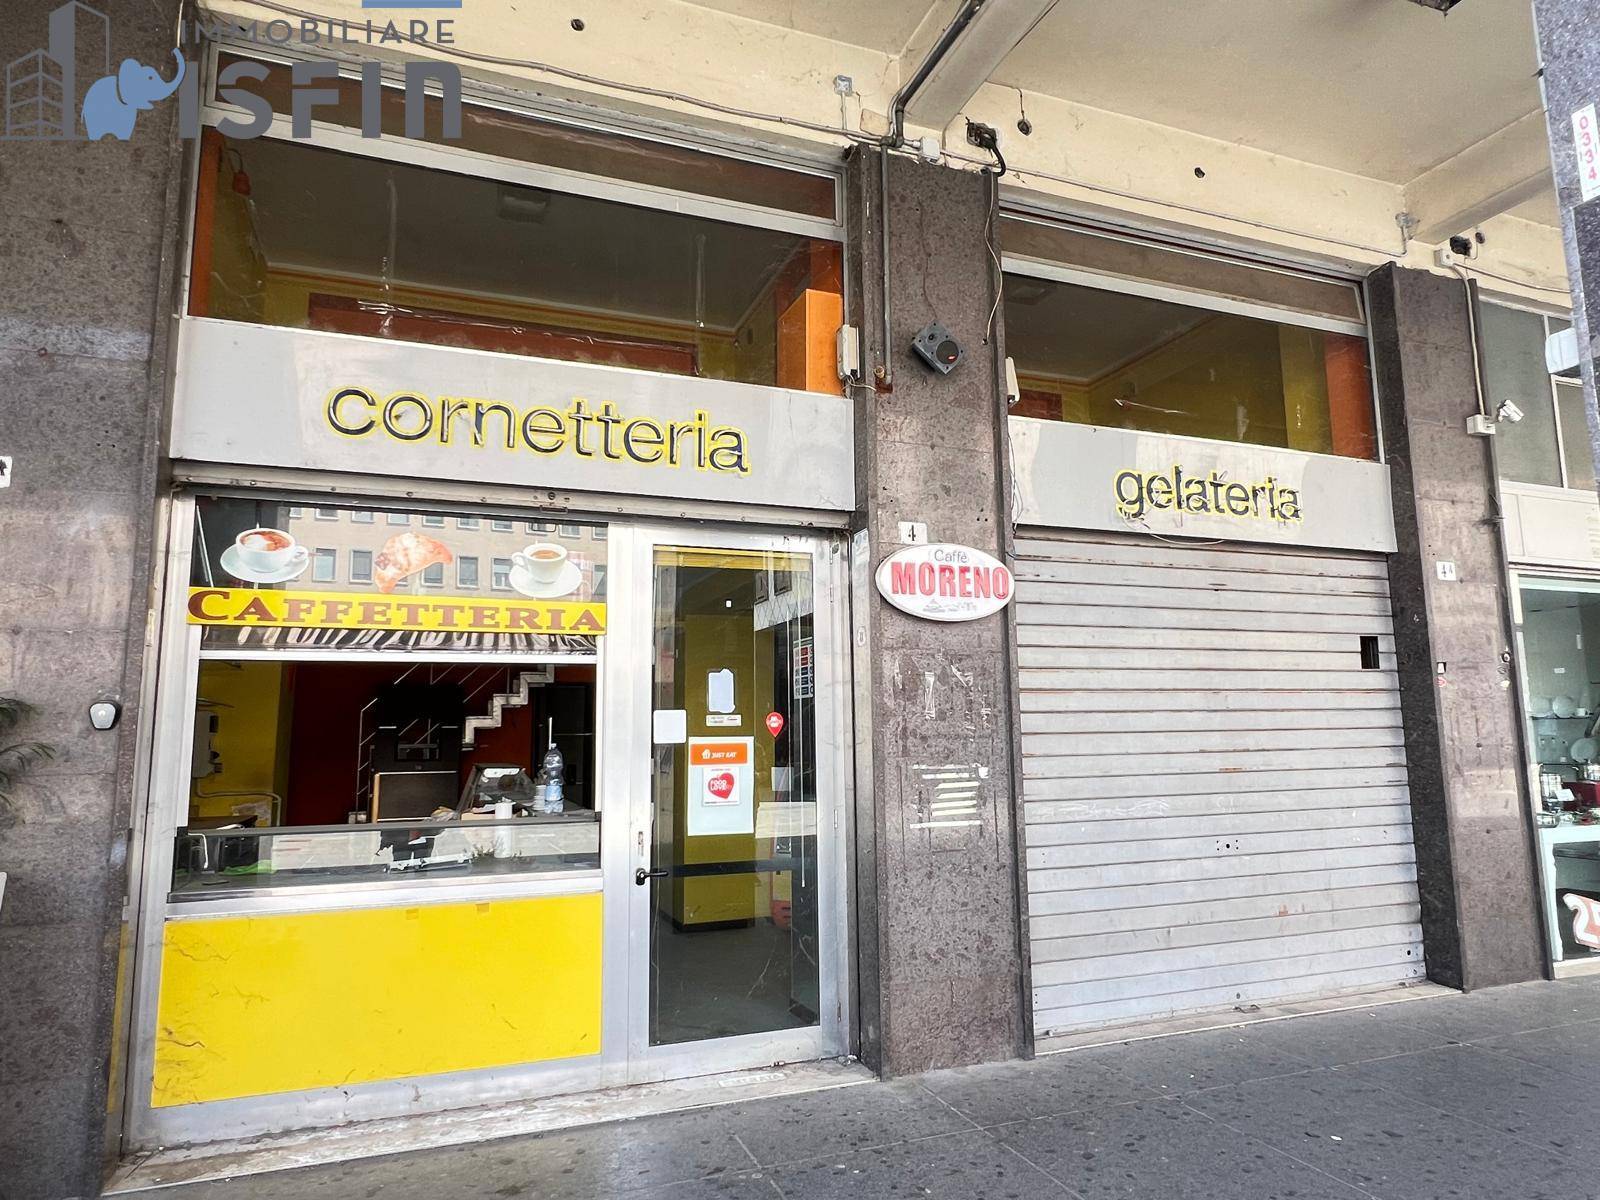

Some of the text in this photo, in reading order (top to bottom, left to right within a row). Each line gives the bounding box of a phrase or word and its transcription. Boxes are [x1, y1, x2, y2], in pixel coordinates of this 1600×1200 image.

[1579, 115, 1597, 180] 0334
[327, 386, 751, 474] cornetteria
[1114, 464, 1302, 523] gelateria
[908, 524, 917, 542] 4
[891, 562, 1009, 600] MORENO
[187, 590, 606, 632] CAFFETTERIA
